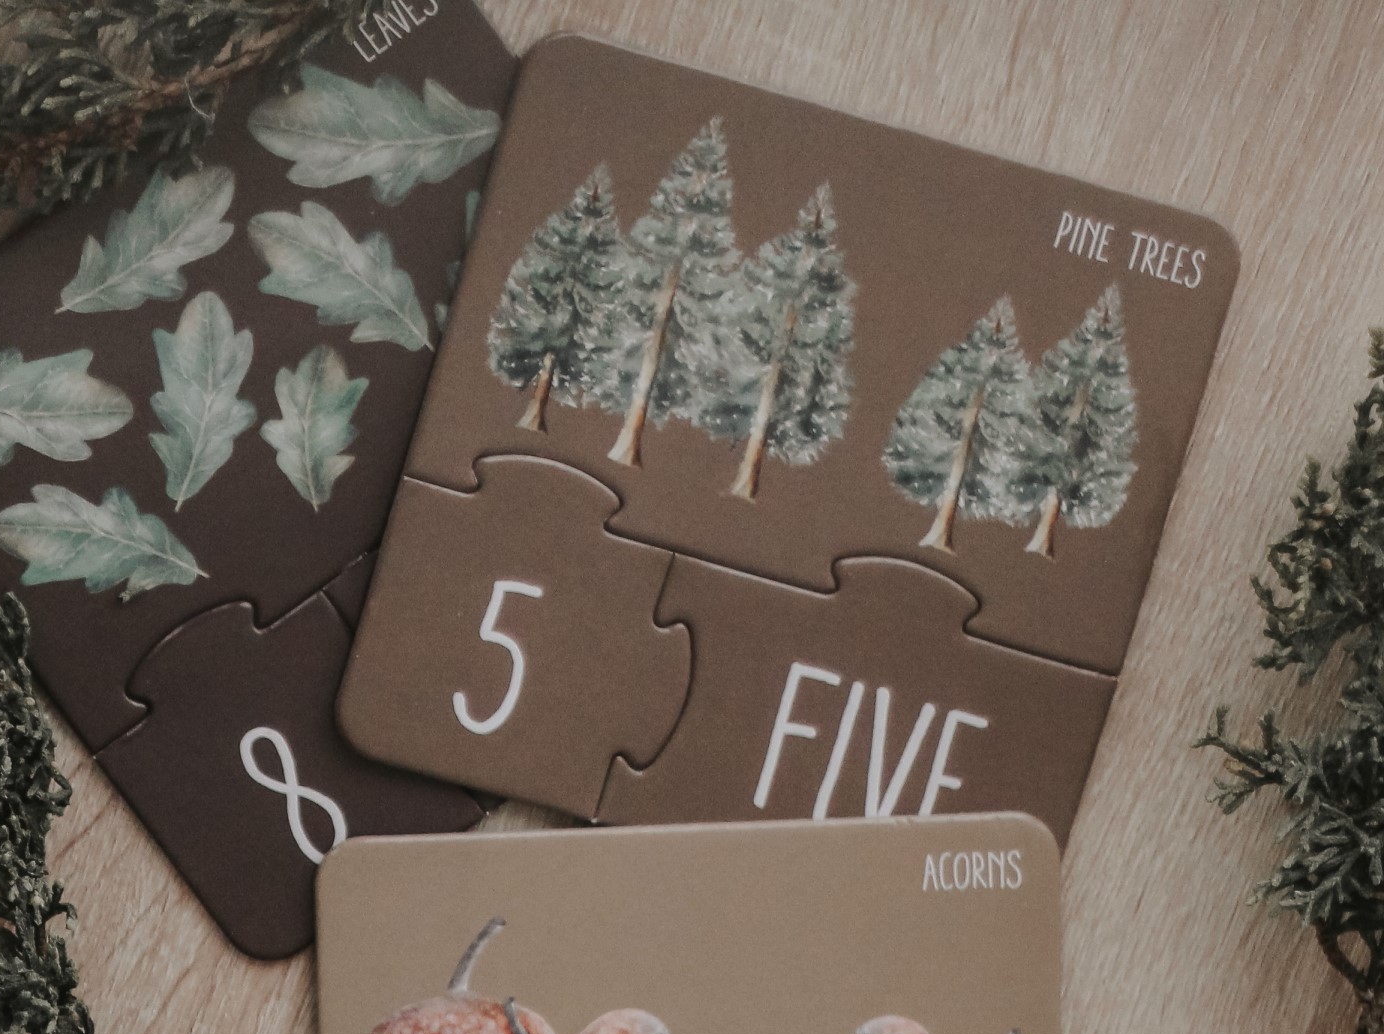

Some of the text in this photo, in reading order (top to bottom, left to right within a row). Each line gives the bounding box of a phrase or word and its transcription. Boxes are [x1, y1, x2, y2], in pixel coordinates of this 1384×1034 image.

[1053, 210, 1206, 289] PINE TREES
[453, 580, 543, 735] 5
[239, 726, 347, 865] 8
[922, 849, 1022, 891] ACORNS
